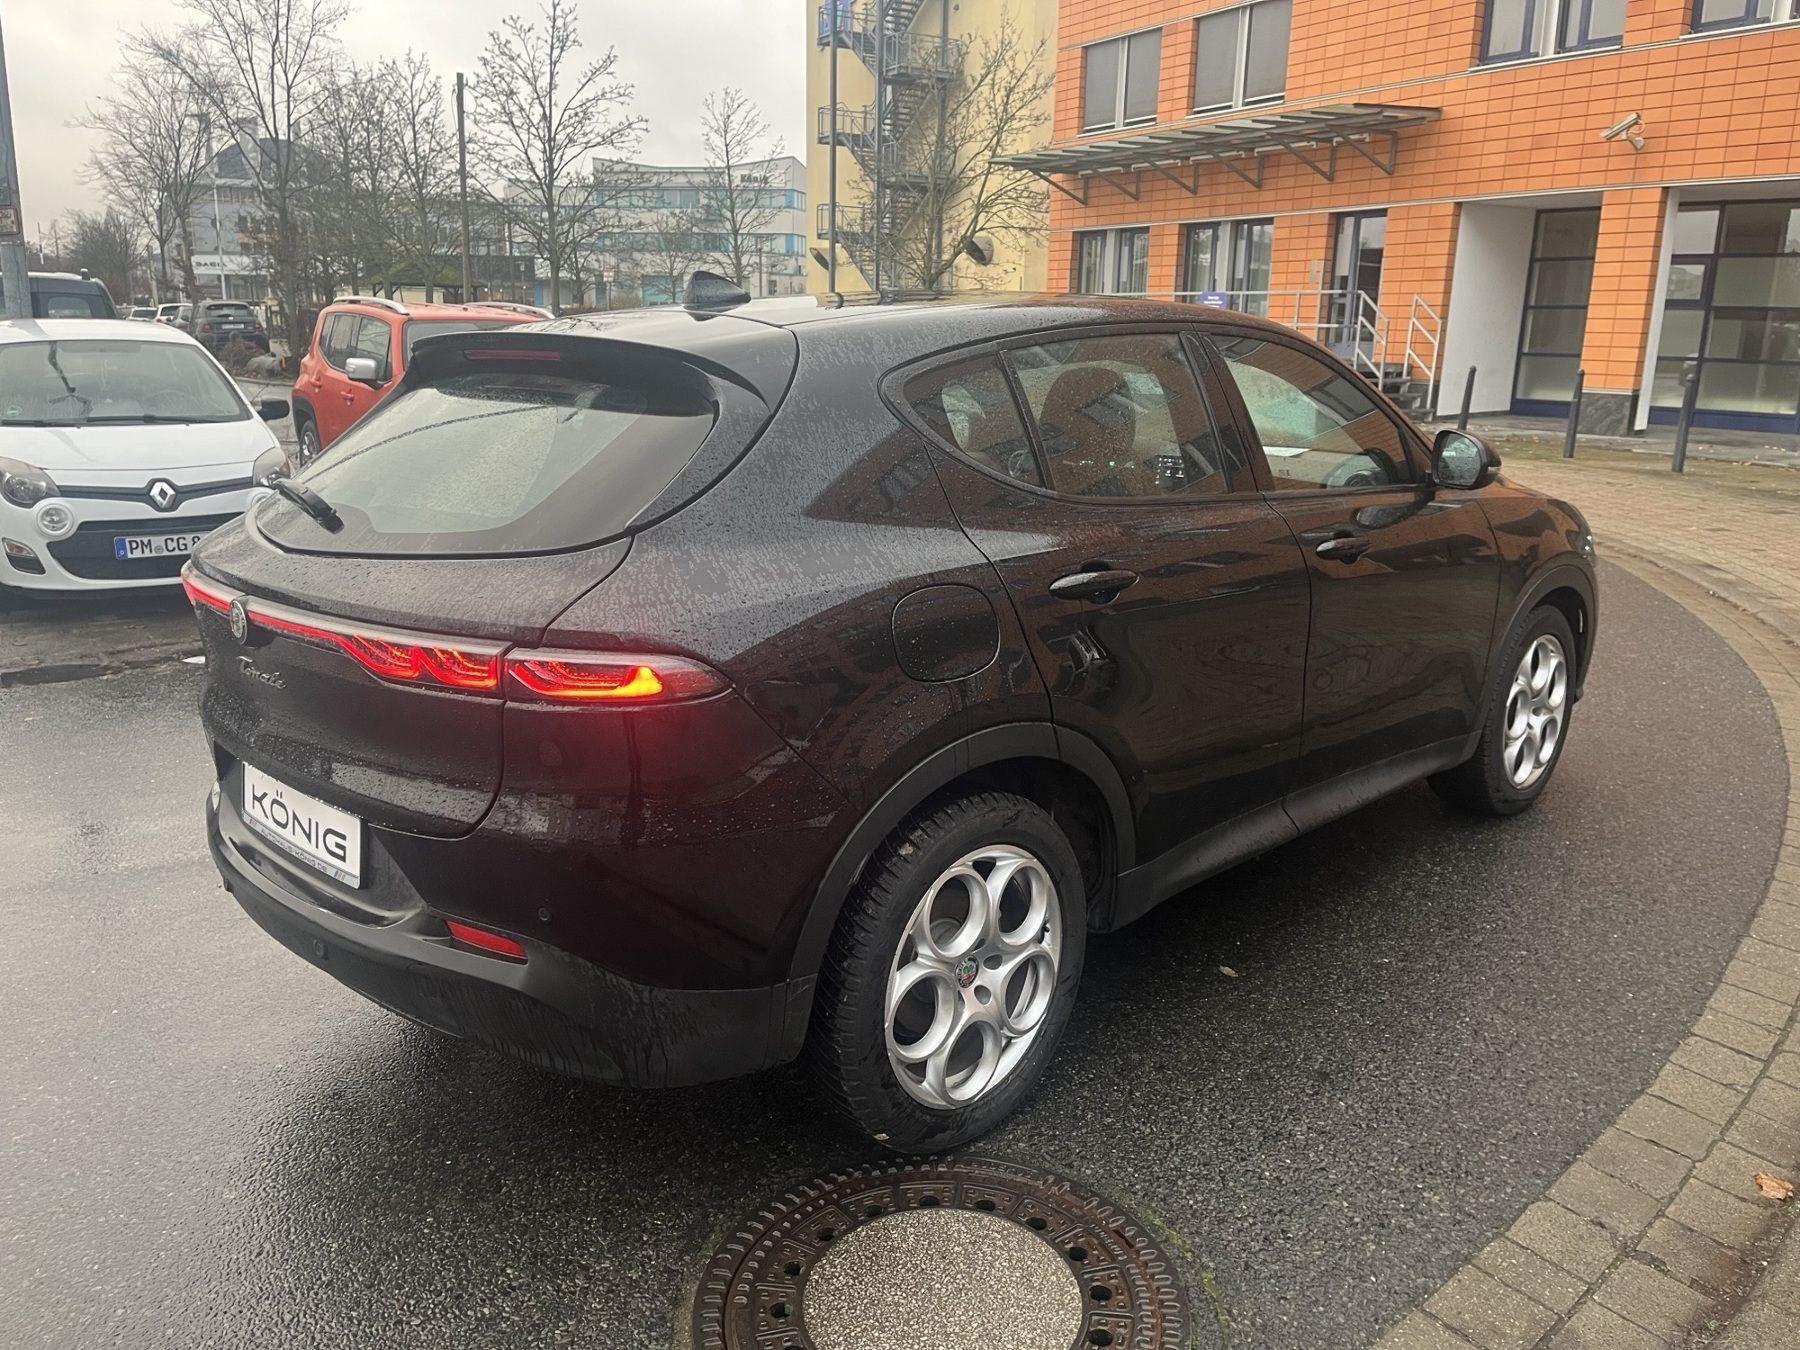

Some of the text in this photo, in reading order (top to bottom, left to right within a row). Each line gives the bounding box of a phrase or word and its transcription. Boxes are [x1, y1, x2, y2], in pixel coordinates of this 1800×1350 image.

[128, 539, 153, 555] PM
[164, 536, 189, 553] CG
[236, 655, 288, 689] Tonale
[252, 783, 347, 863] KÖNIG
